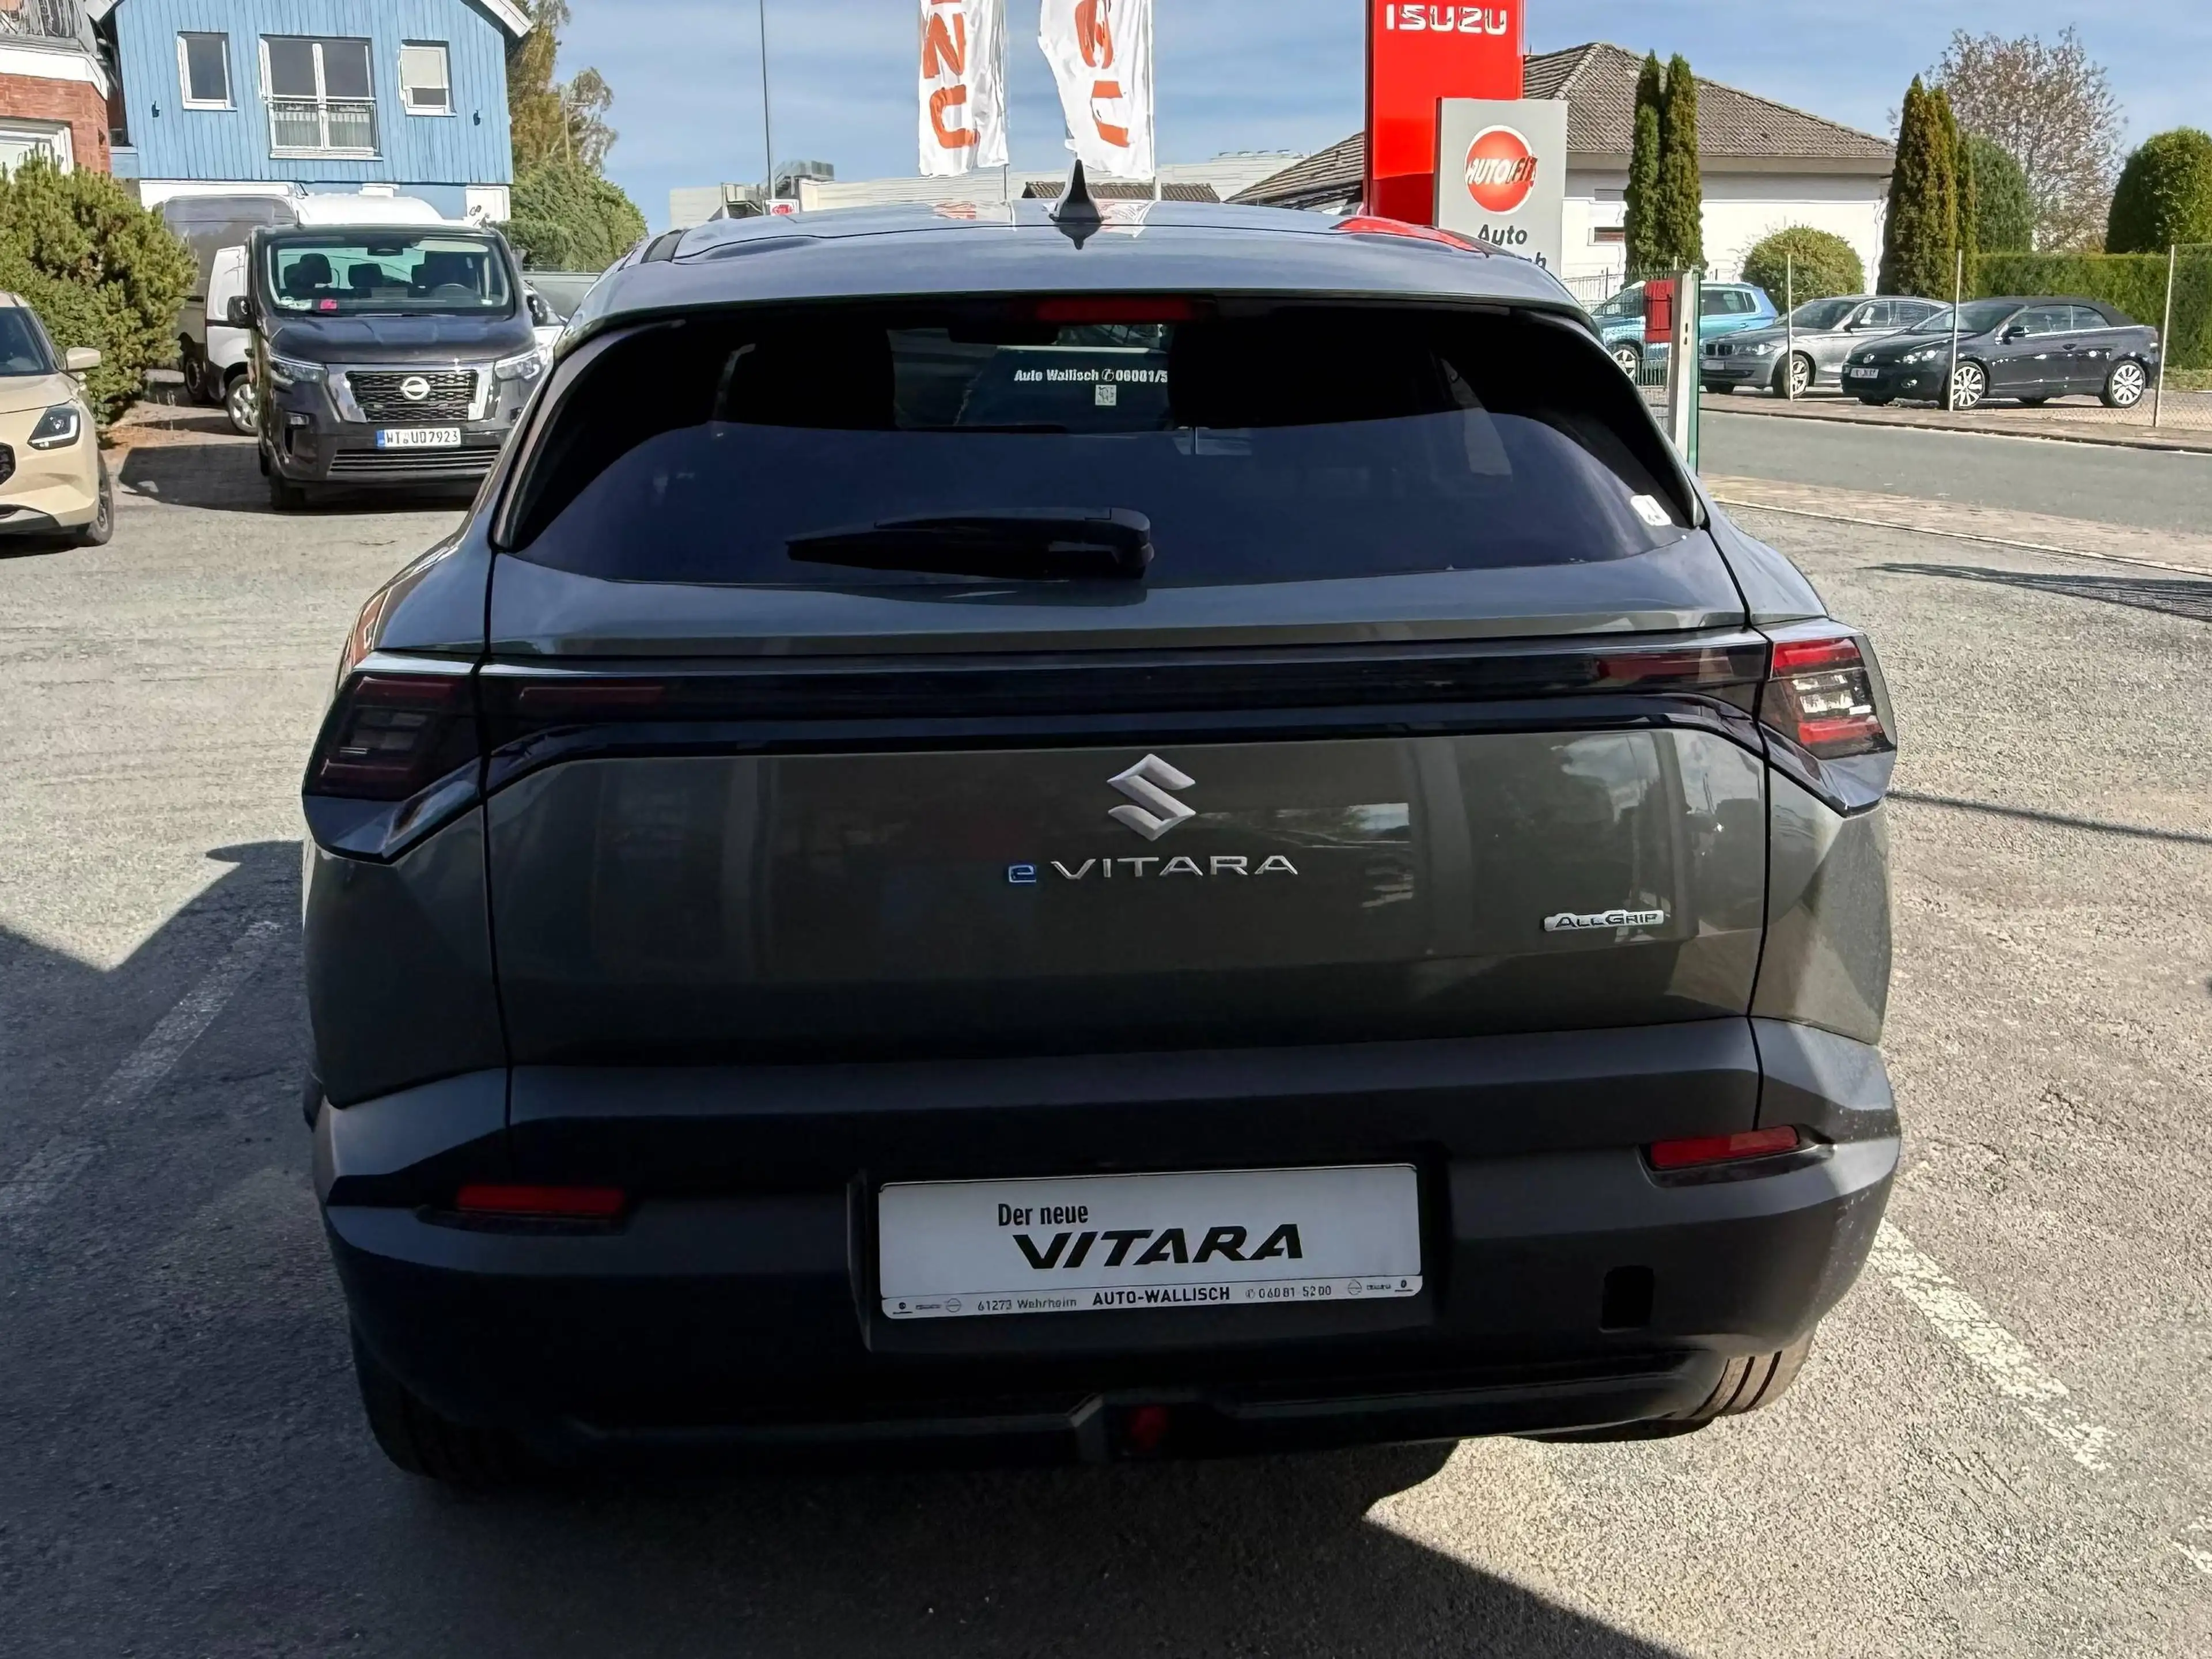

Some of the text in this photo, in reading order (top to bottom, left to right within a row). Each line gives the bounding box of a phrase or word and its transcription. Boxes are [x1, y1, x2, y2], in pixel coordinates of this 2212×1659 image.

[1386, 4, 1508, 35] ISUZU
[1478, 224, 1528, 246] Auto
[1014, 370, 1043, 381] Auto
[1046, 369, 1099, 381] Wallisch
[1050, 855, 1298, 880] VITARA
[998, 1203, 1088, 1226] Der neue
[1012, 1224, 1303, 1269] VITARA
[978, 1300, 1012, 1311] 61273
[1017, 1296, 1077, 1309] Wehrheim
[1093, 1286, 1230, 1306] AUTO-WALLISCH
